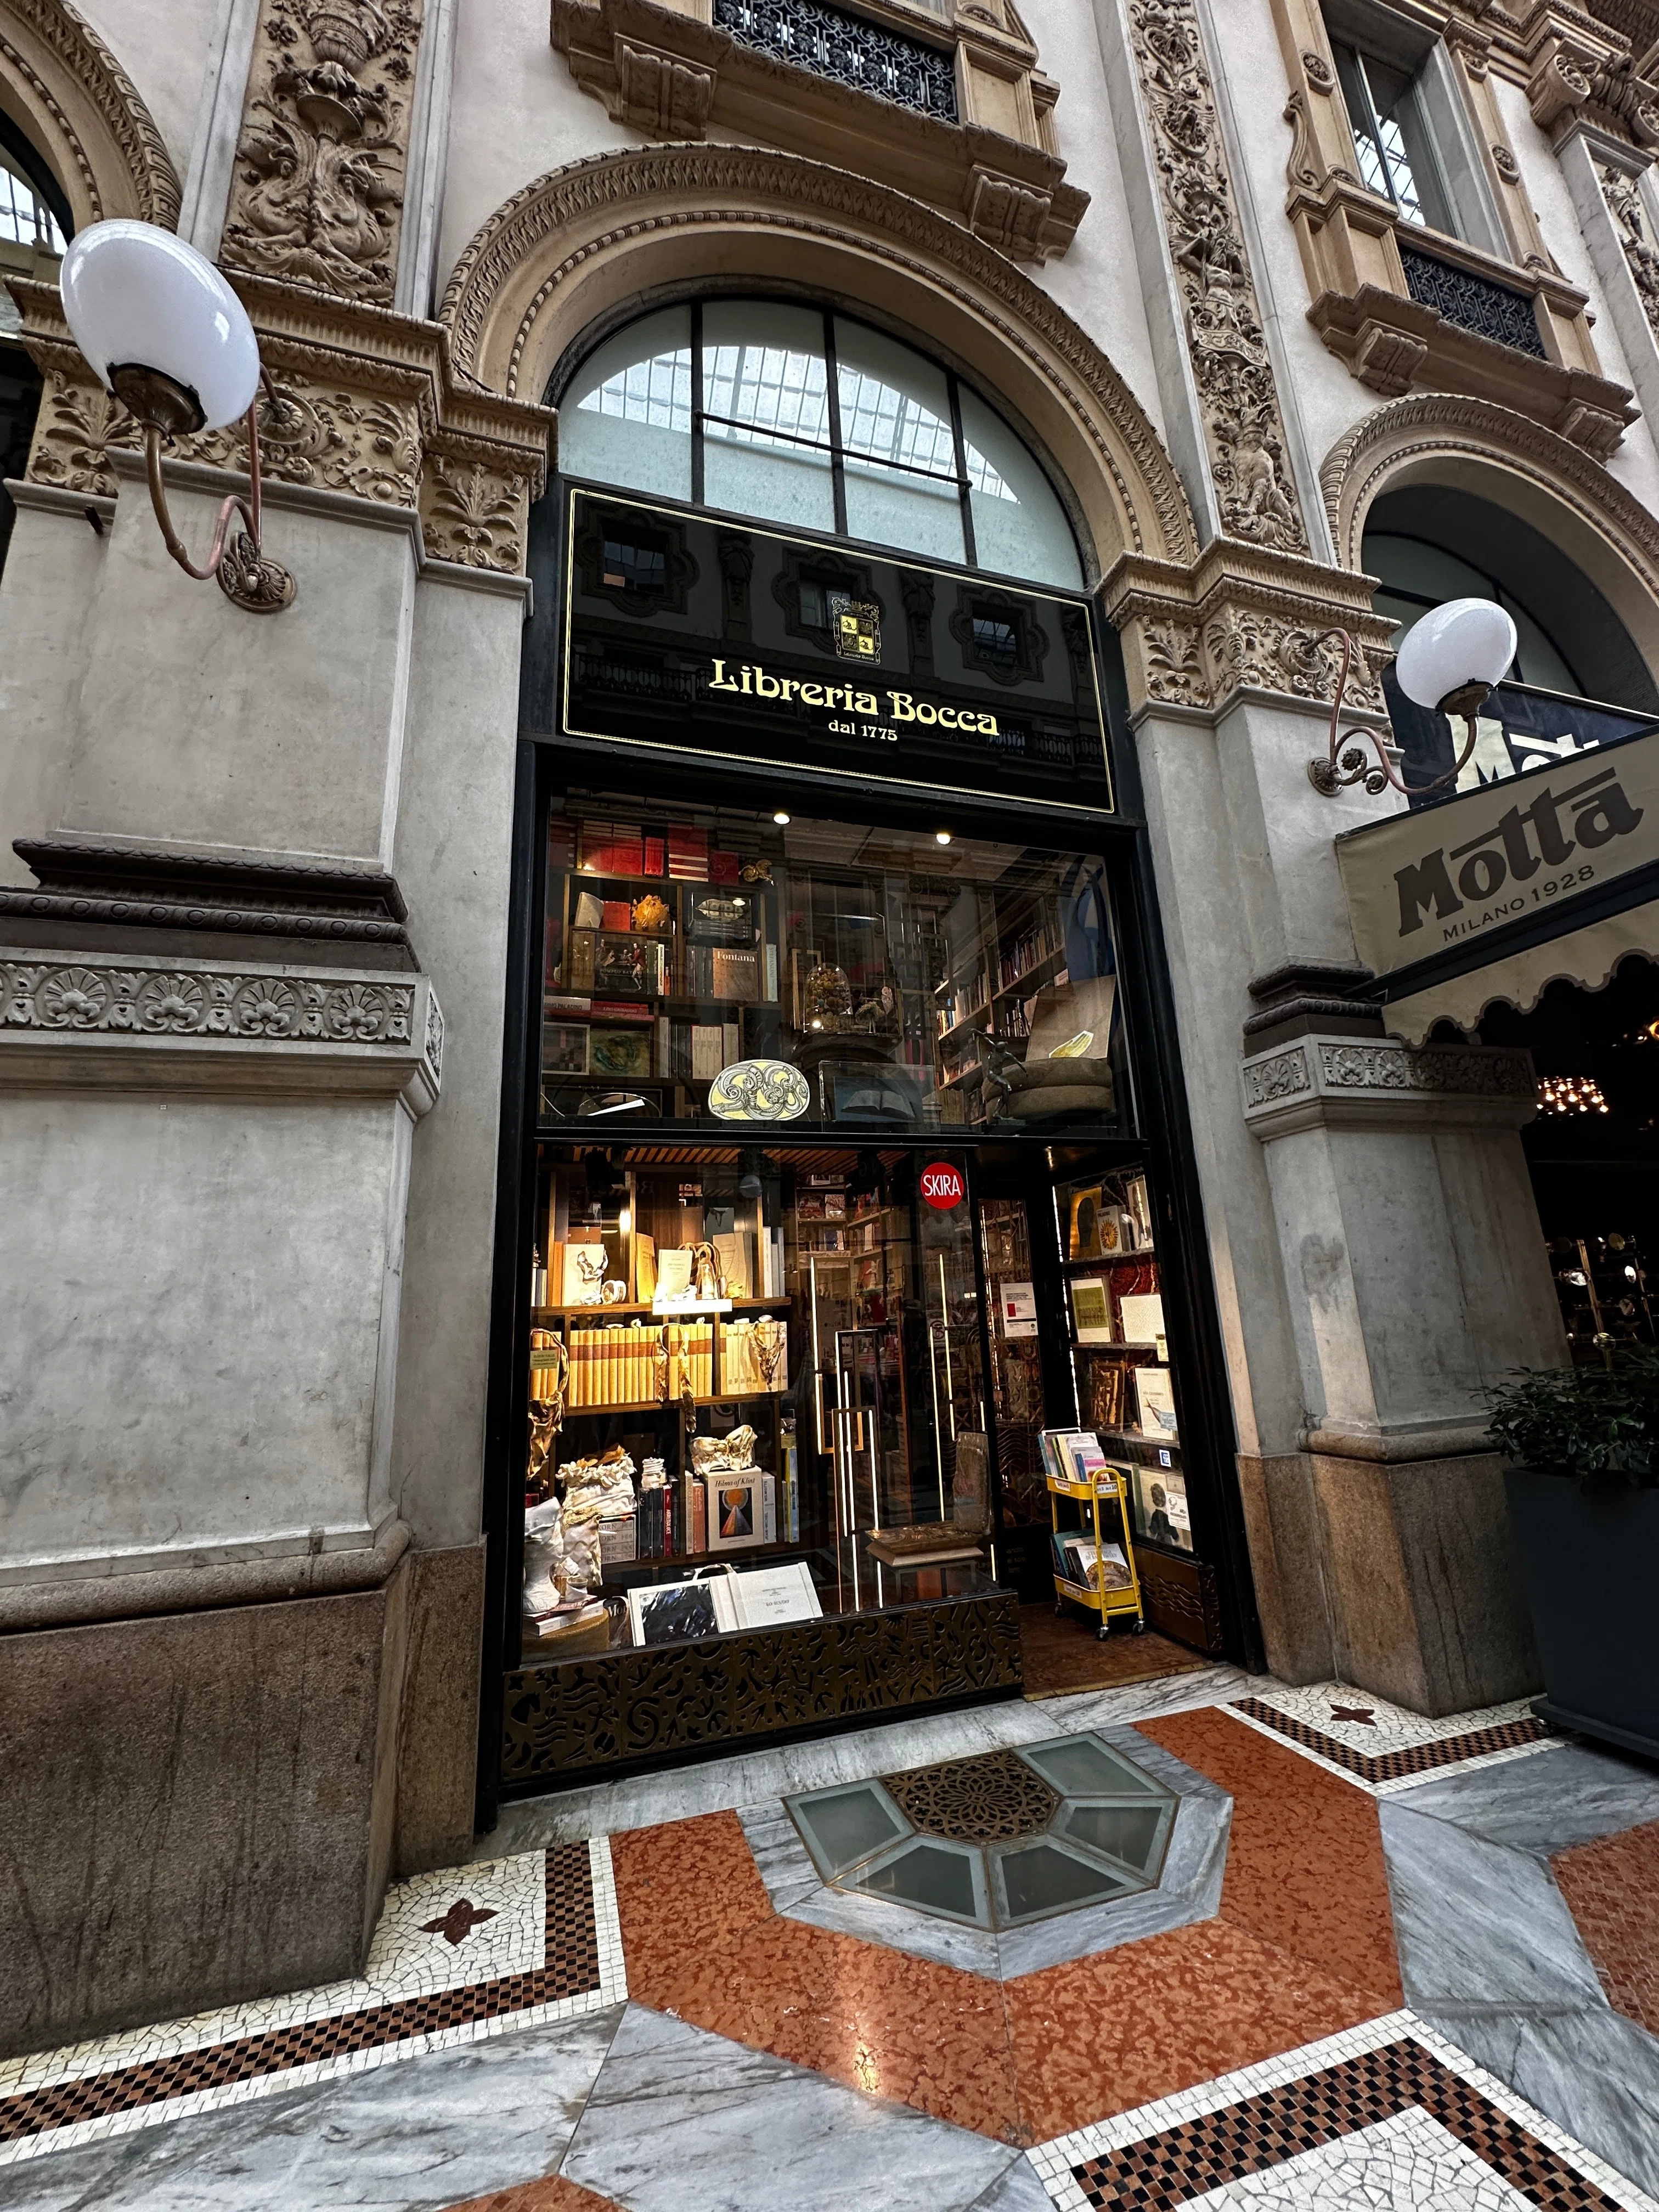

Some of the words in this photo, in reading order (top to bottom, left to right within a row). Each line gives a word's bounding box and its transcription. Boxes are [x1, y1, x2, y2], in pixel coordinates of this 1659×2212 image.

[708, 658, 879, 715] Libreria
[886, 691, 1000, 736] Bocca
[828, 719, 856, 735] dal
[861, 725, 898, 741] 1775
[1393, 766, 1644, 938] Motta
[1442, 898, 1525, 943] MILANO
[1531, 865, 1595, 902] 1928
[717, 951, 755, 962] Fontana
[923, 1175, 962, 1197] SKIRA
[733, 1477, 741, 1487] af
